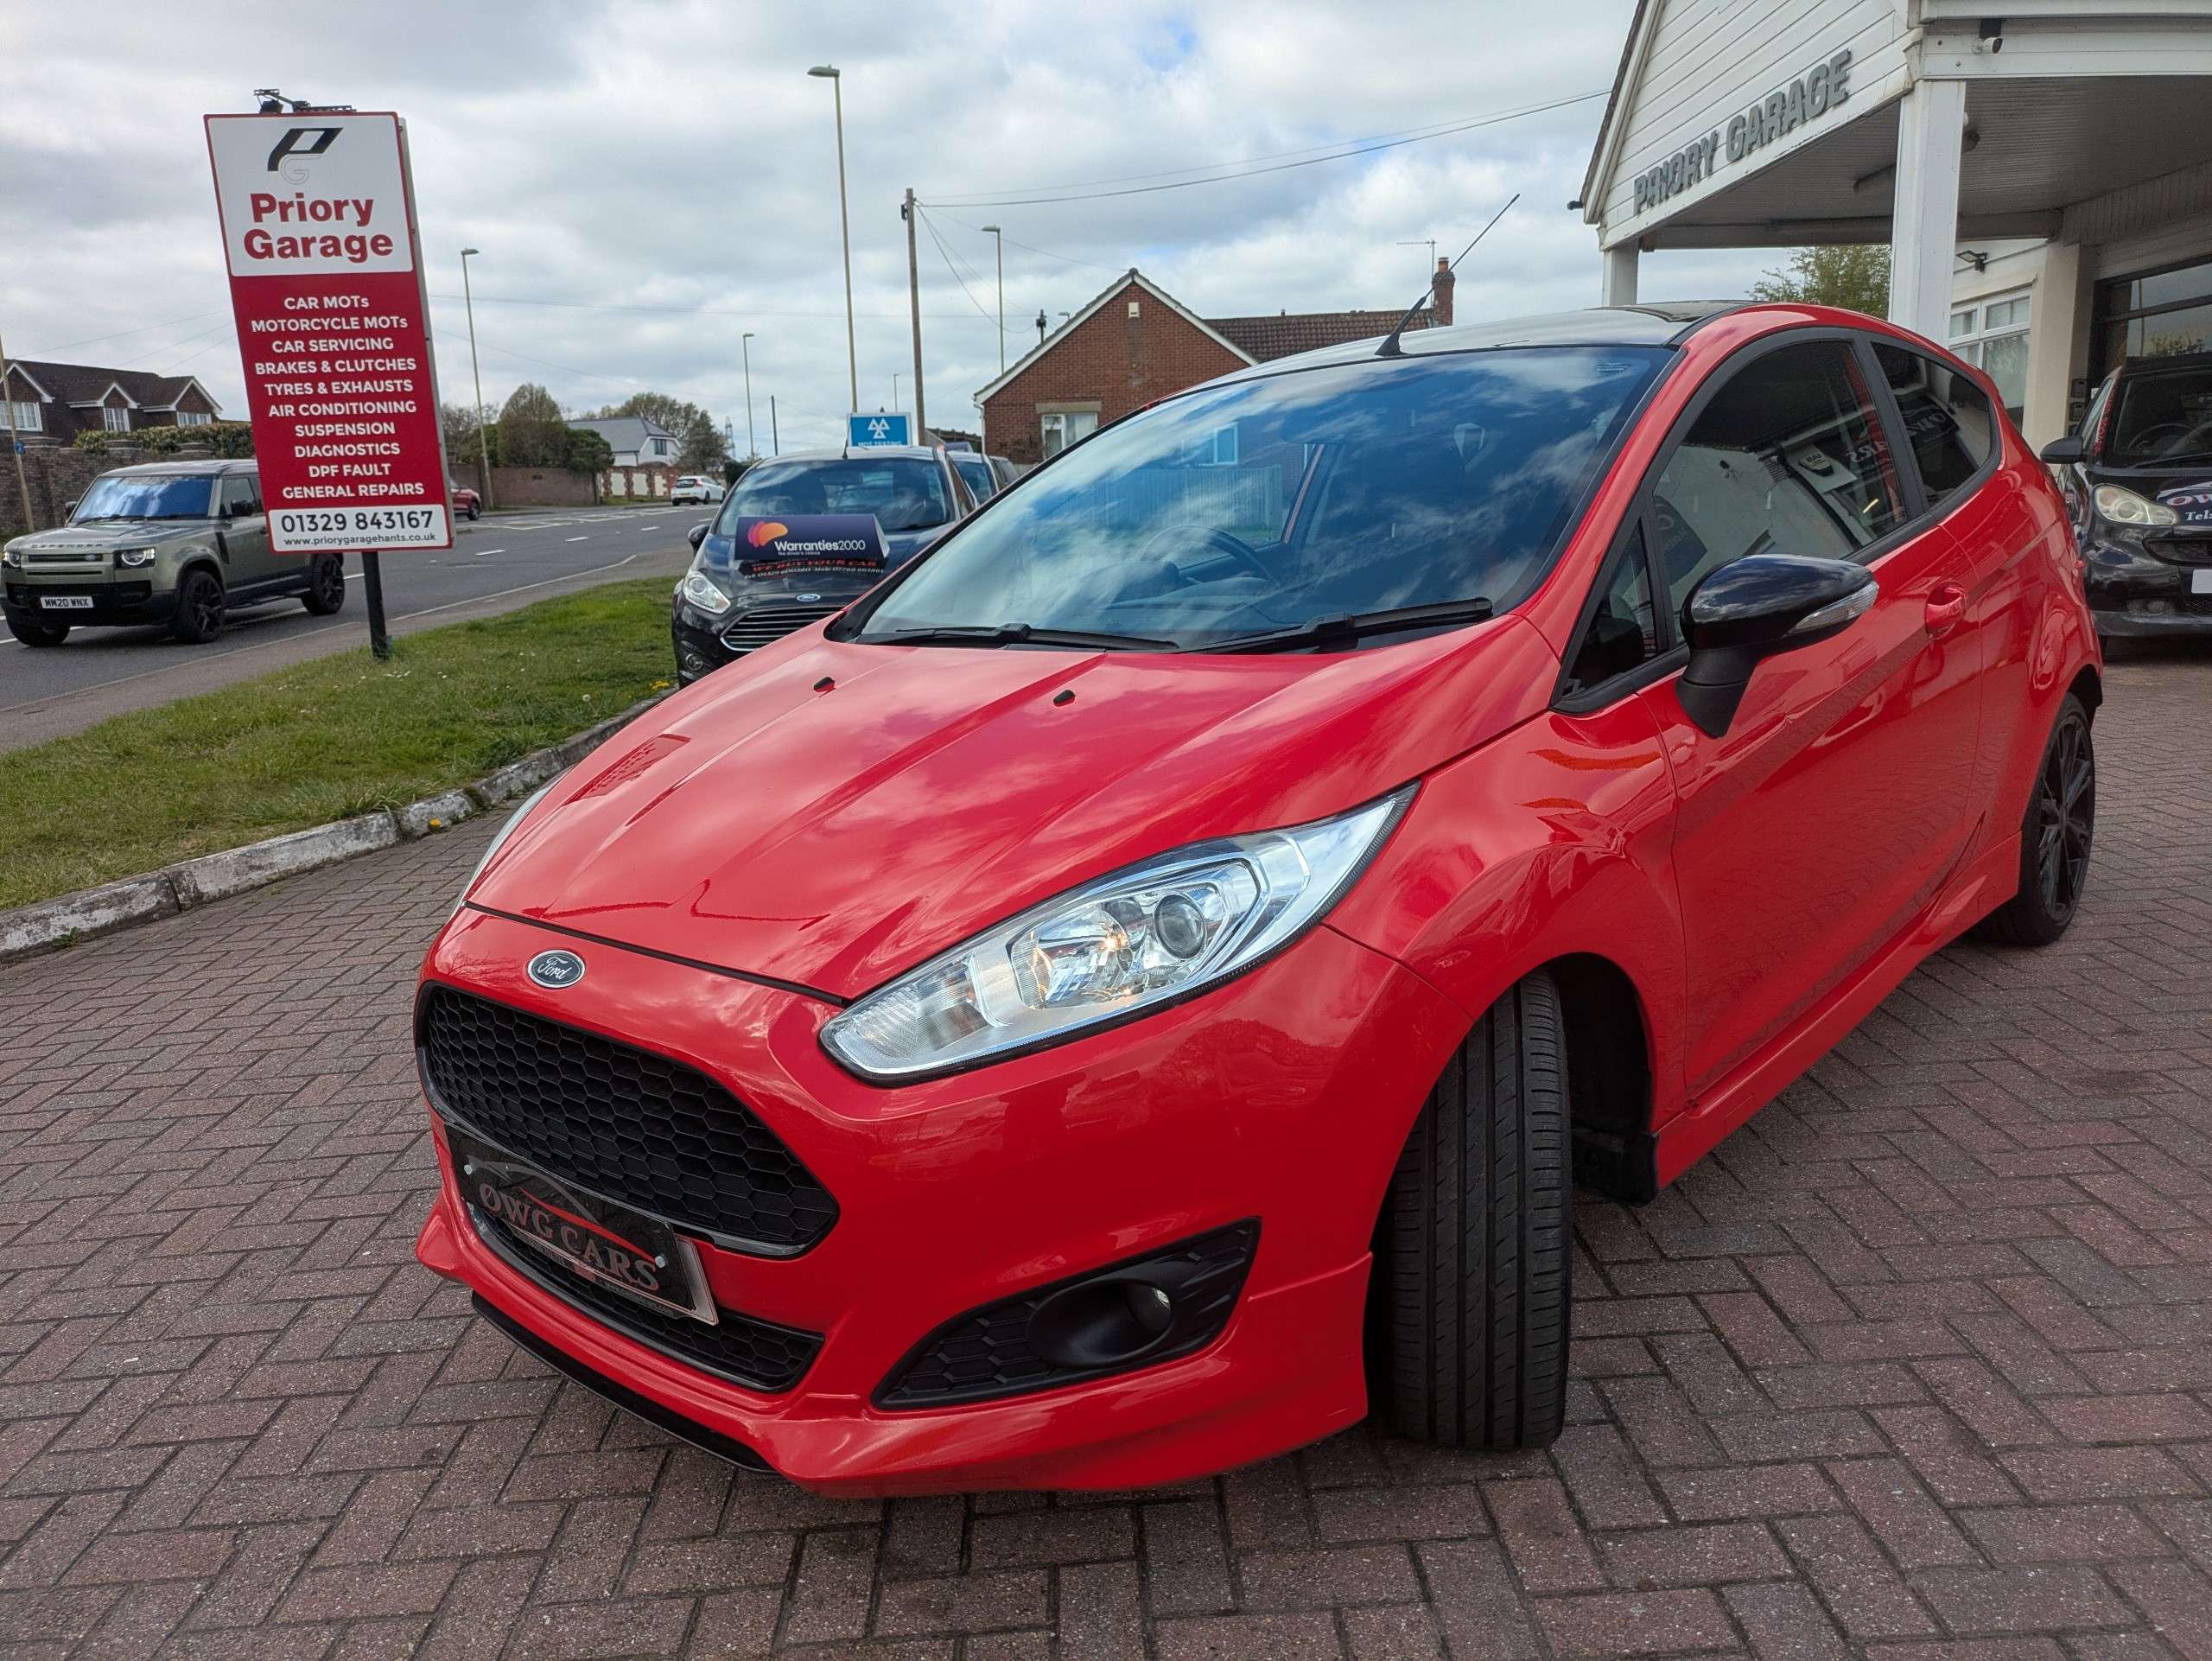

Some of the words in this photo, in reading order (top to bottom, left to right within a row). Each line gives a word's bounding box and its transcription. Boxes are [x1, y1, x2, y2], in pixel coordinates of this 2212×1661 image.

[1632, 130, 1719, 216] PRIORY
[1725, 48, 1853, 164] GARAGE
[250, 192, 374, 227] Priory
[243, 228, 394, 264] Garage
[283, 297, 319, 310] CAR
[323, 296, 370, 309] MOTs
[251, 317, 359, 333] MOTORCYCLE
[363, 315, 408, 329] MOTs
[271, 340, 305, 353] CAR
[308, 337, 394, 352] SERVICING
[255, 361, 317, 375] BRAKES
[321, 360, 332, 373] &
[334, 358, 417, 372] CLUTCHES
[264, 383, 314, 396] TYRES
[317, 381, 328, 395] &
[331, 379, 413, 394] EXHAUSTS
[269, 404, 295, 417] AIR
[298, 401, 417, 417] CONDITIONING
[295, 422, 395, 437] SUSPENSION
[294, 442, 401, 458] DIAGNOSTICS
[308, 465, 339, 478] DPF
[342, 463, 391, 476] FAULT
[282, 485, 355, 499] GENERAL
[359, 482, 425, 497] REPAIRS
[281, 513, 346, 533] 01329
[355, 510, 433, 531] 843167
[283, 532, 436, 548] www.priorygaragehants.co.uk
[774, 539, 866, 552] Warranties2000
[537, 956, 574, 980] Ford
[479, 1182, 555, 1238] OWG
[561, 1225, 659, 1292] CARS
